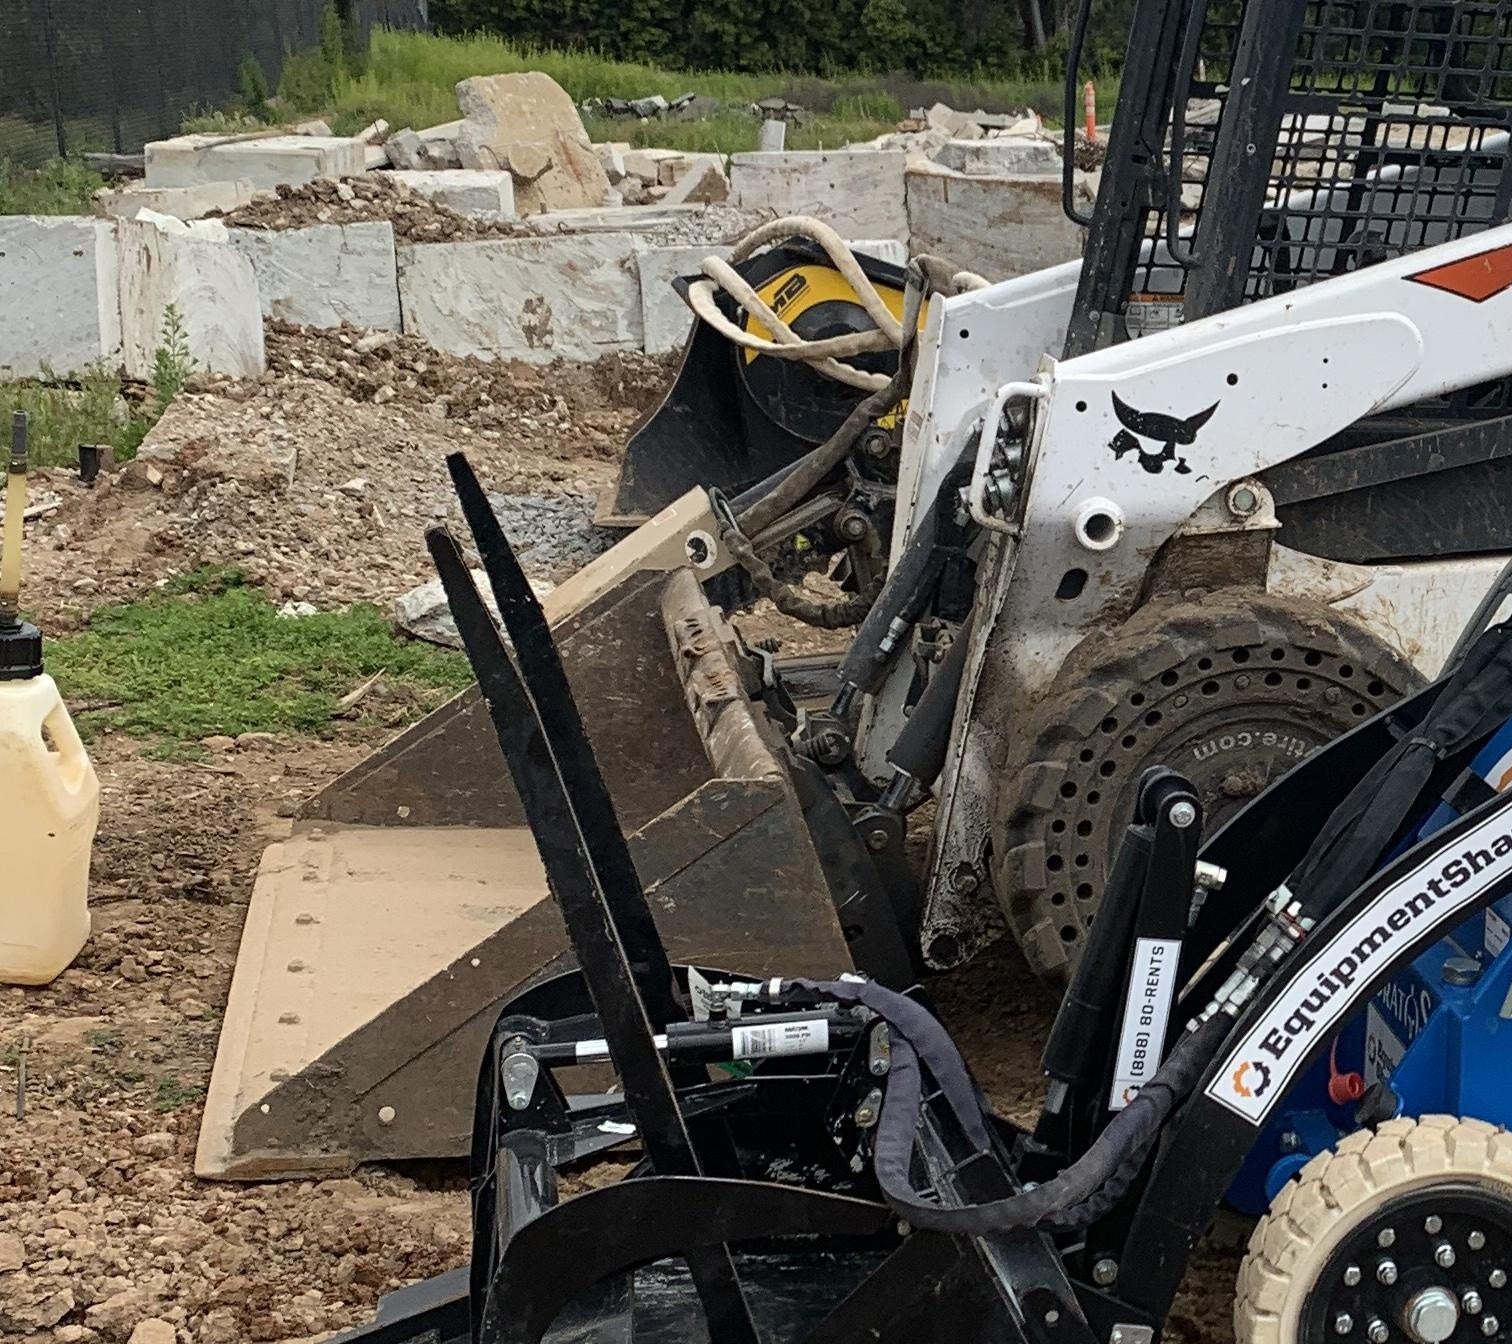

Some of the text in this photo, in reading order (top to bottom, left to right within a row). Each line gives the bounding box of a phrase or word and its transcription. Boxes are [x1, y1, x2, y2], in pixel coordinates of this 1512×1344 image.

[1193, 731, 1320, 761] tire.com
[1130, 945, 1165, 1077] (888) 80-RENTS
